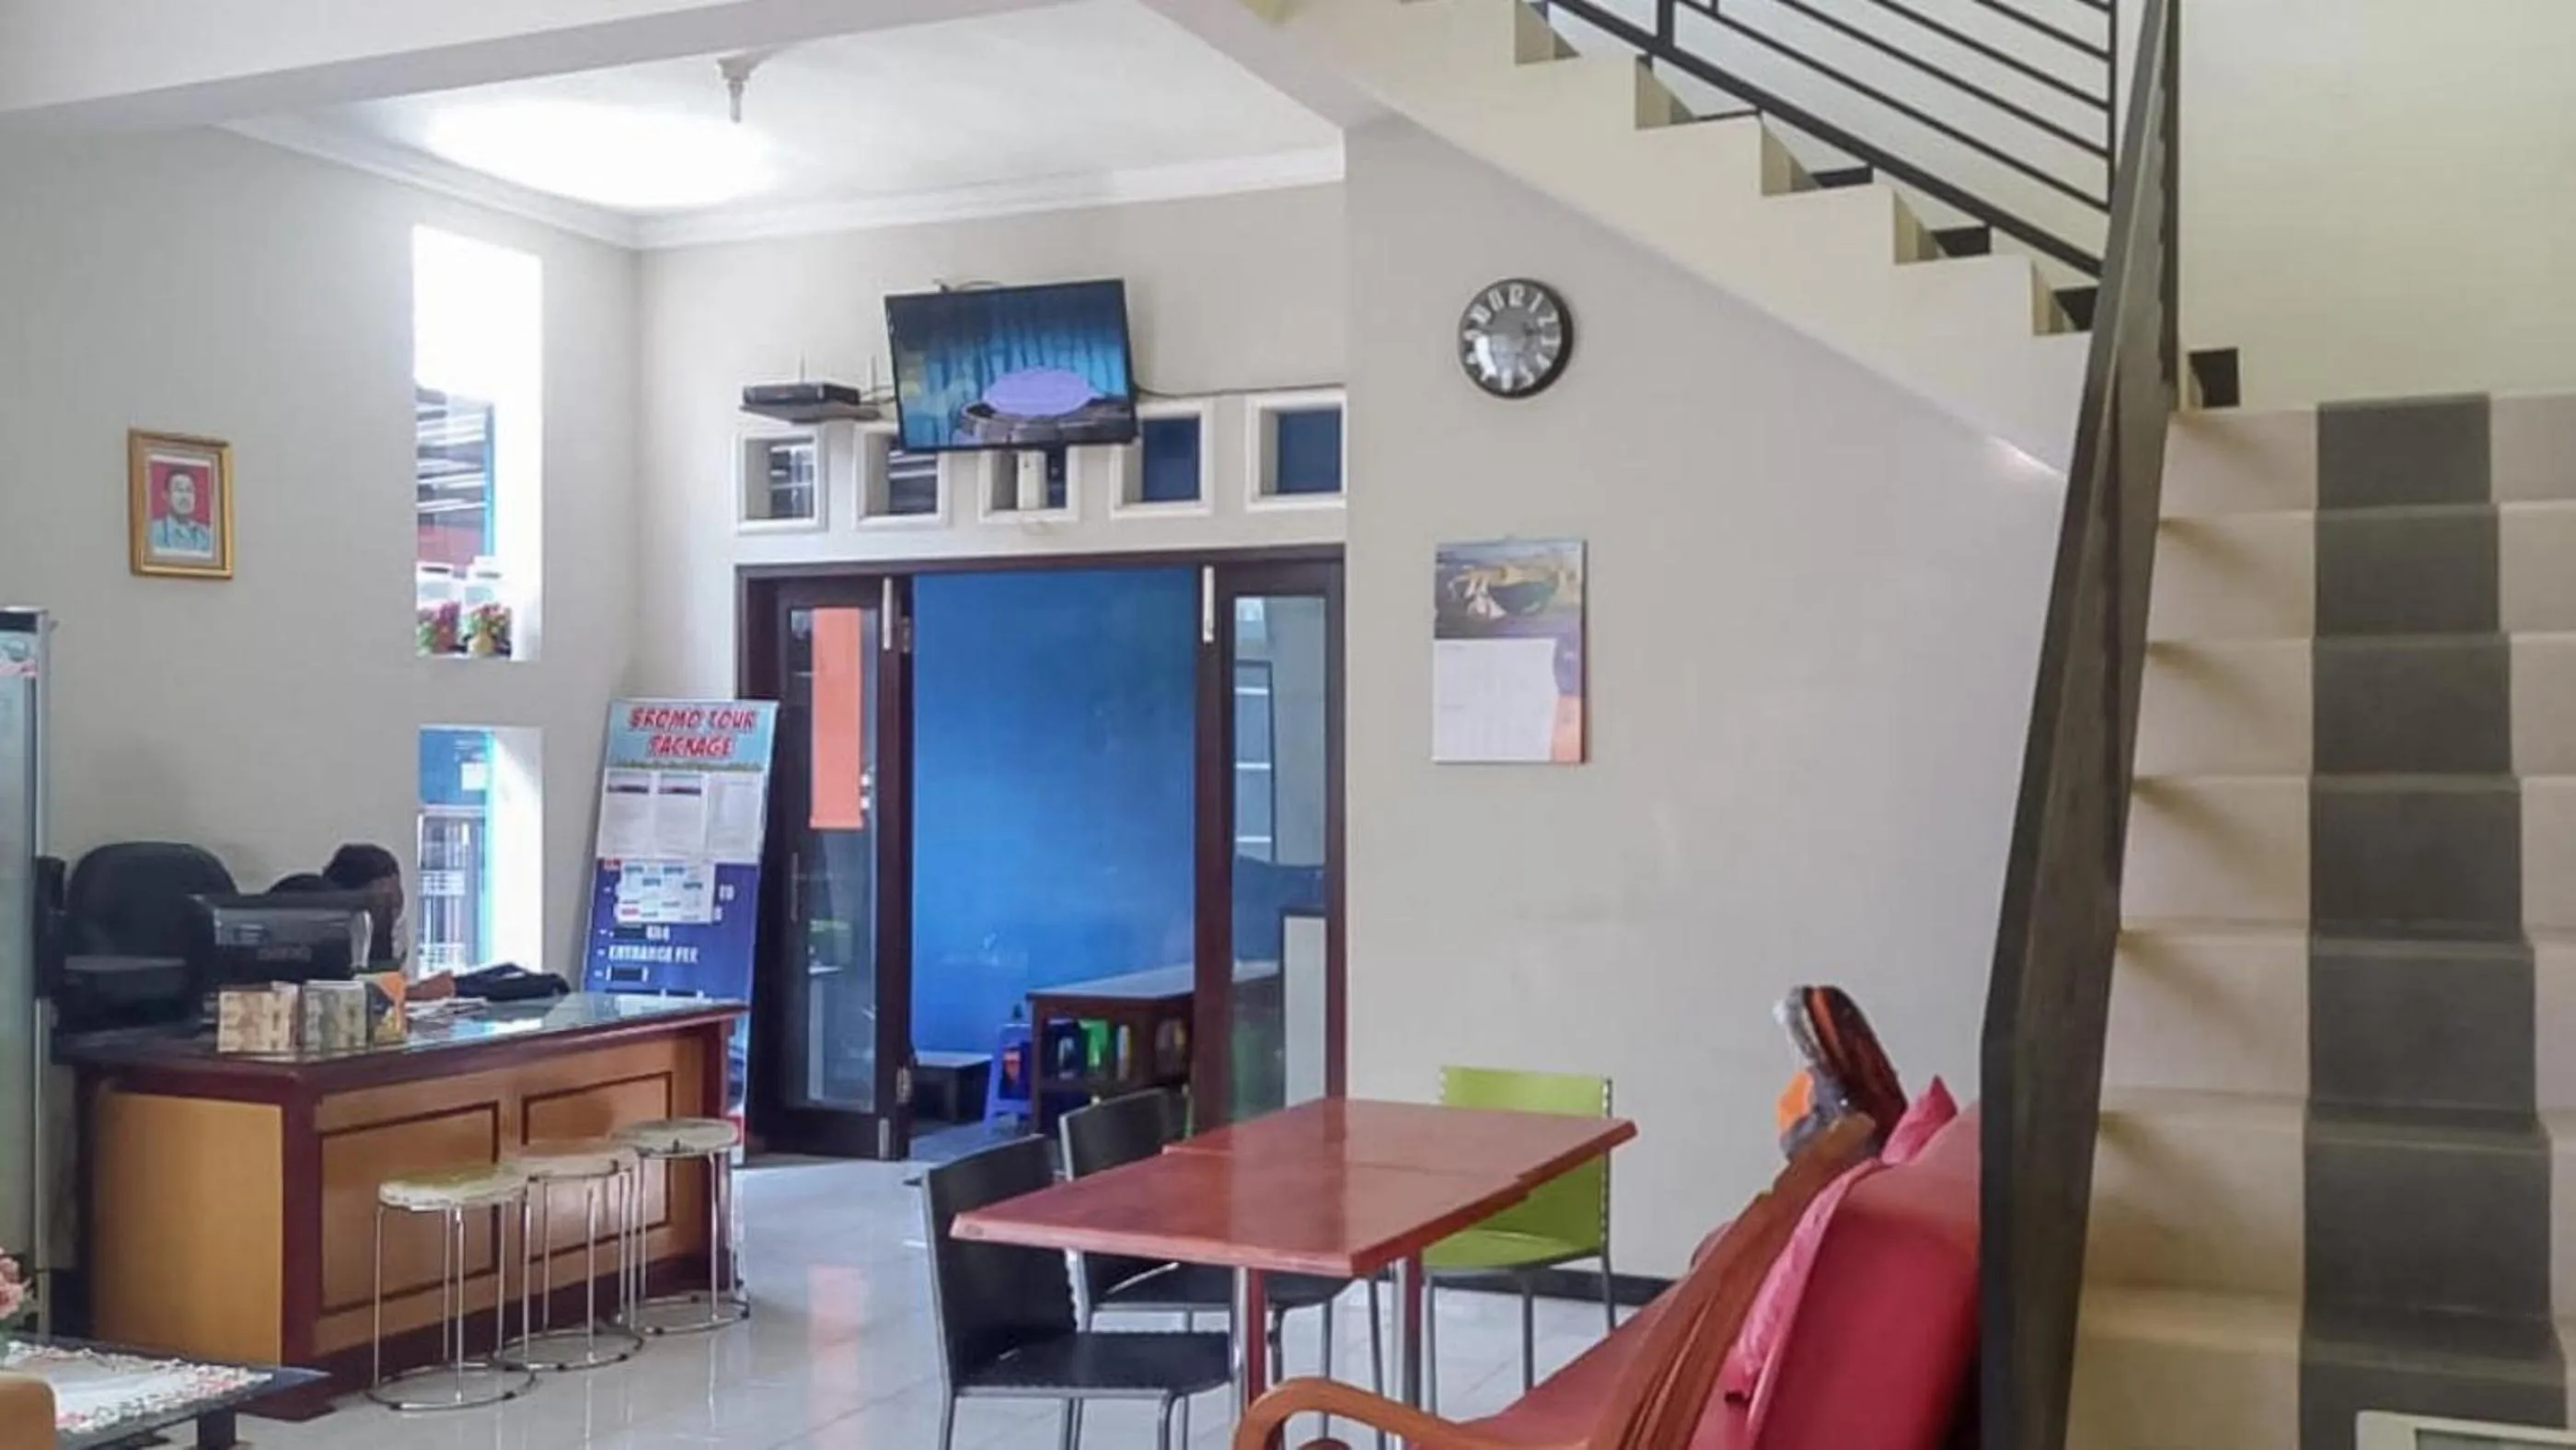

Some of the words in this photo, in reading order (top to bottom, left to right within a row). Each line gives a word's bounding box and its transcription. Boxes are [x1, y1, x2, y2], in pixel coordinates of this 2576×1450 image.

[630, 707, 702, 729] BROMO
[709, 708, 756, 730] TOUR
[649, 734, 734, 758] PACKAGE
[608, 945, 673, 963] ENTRANCE
[675, 946, 699, 964] FEE
